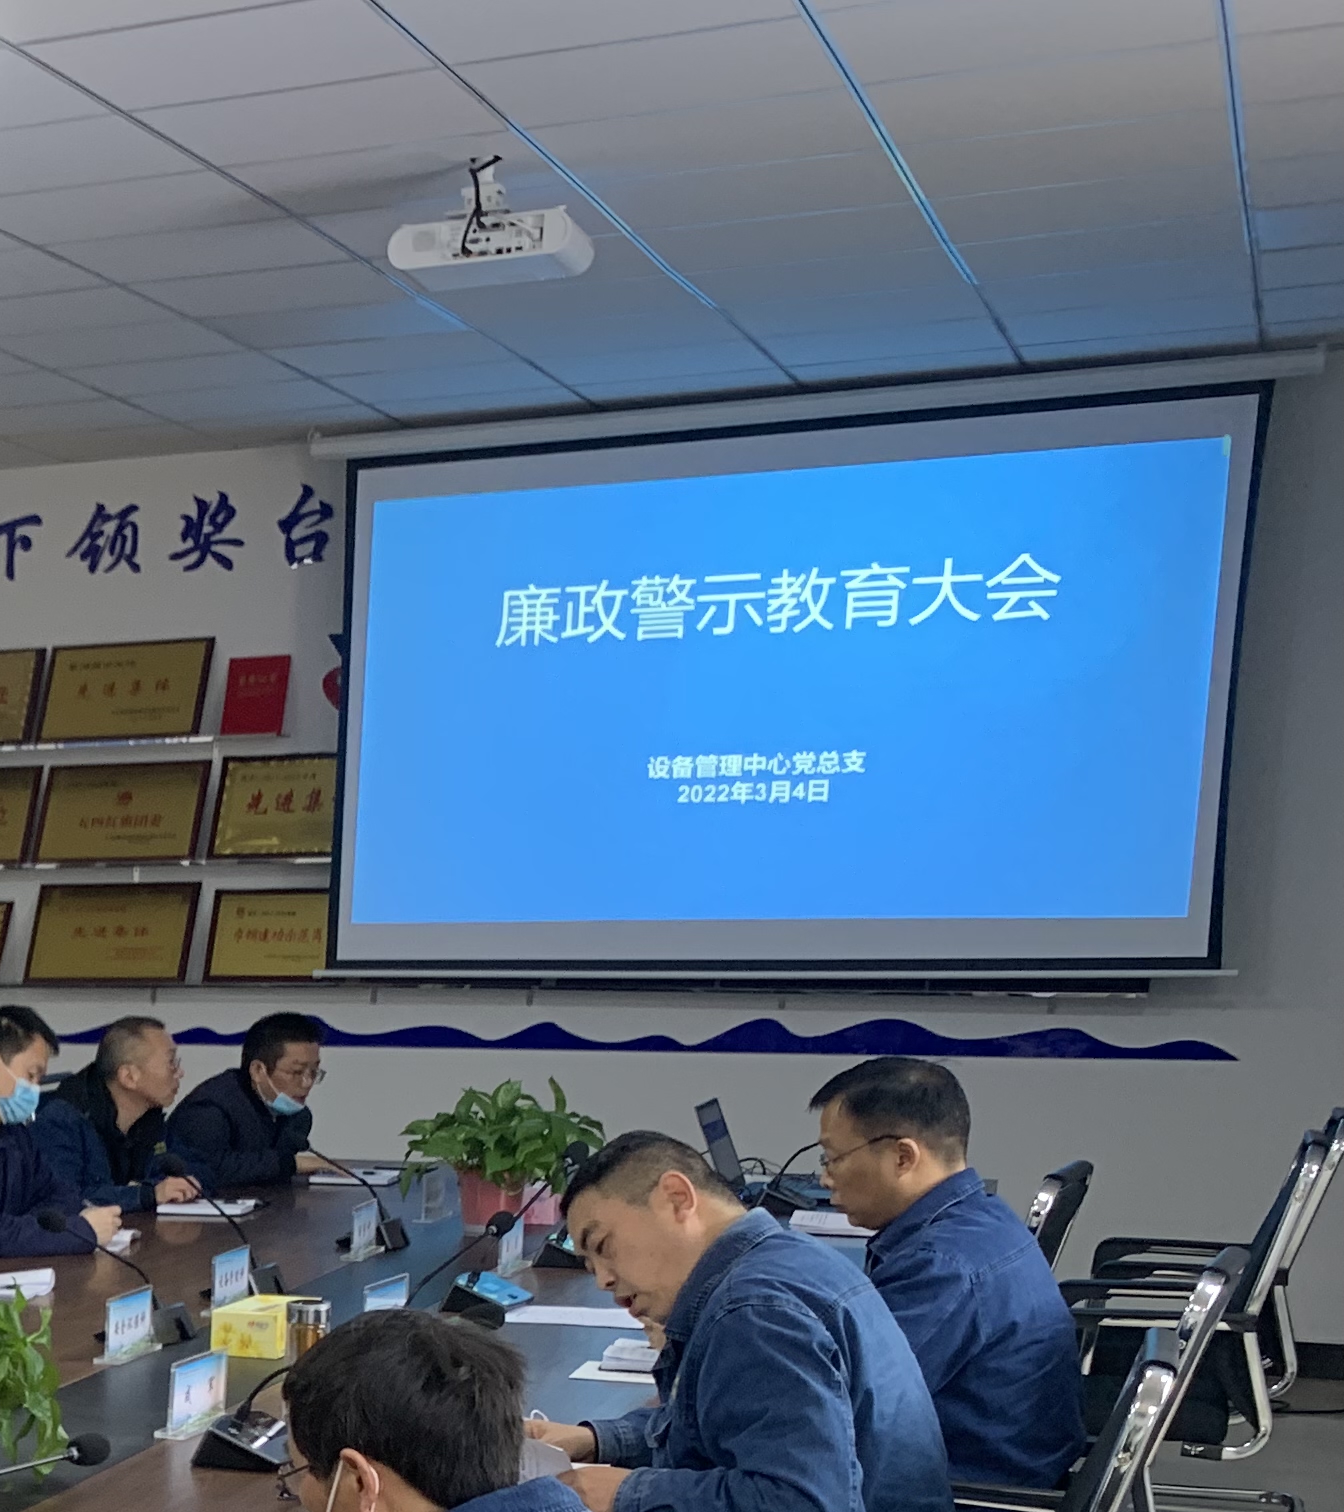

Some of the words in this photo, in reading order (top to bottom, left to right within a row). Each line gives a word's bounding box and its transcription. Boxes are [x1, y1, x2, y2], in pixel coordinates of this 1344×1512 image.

[495, 552, 1062, 648] 廉政警示教育大会
[647, 749, 866, 781] 设备管理中心党总支
[677, 780, 830, 805] 2022年3月4日
